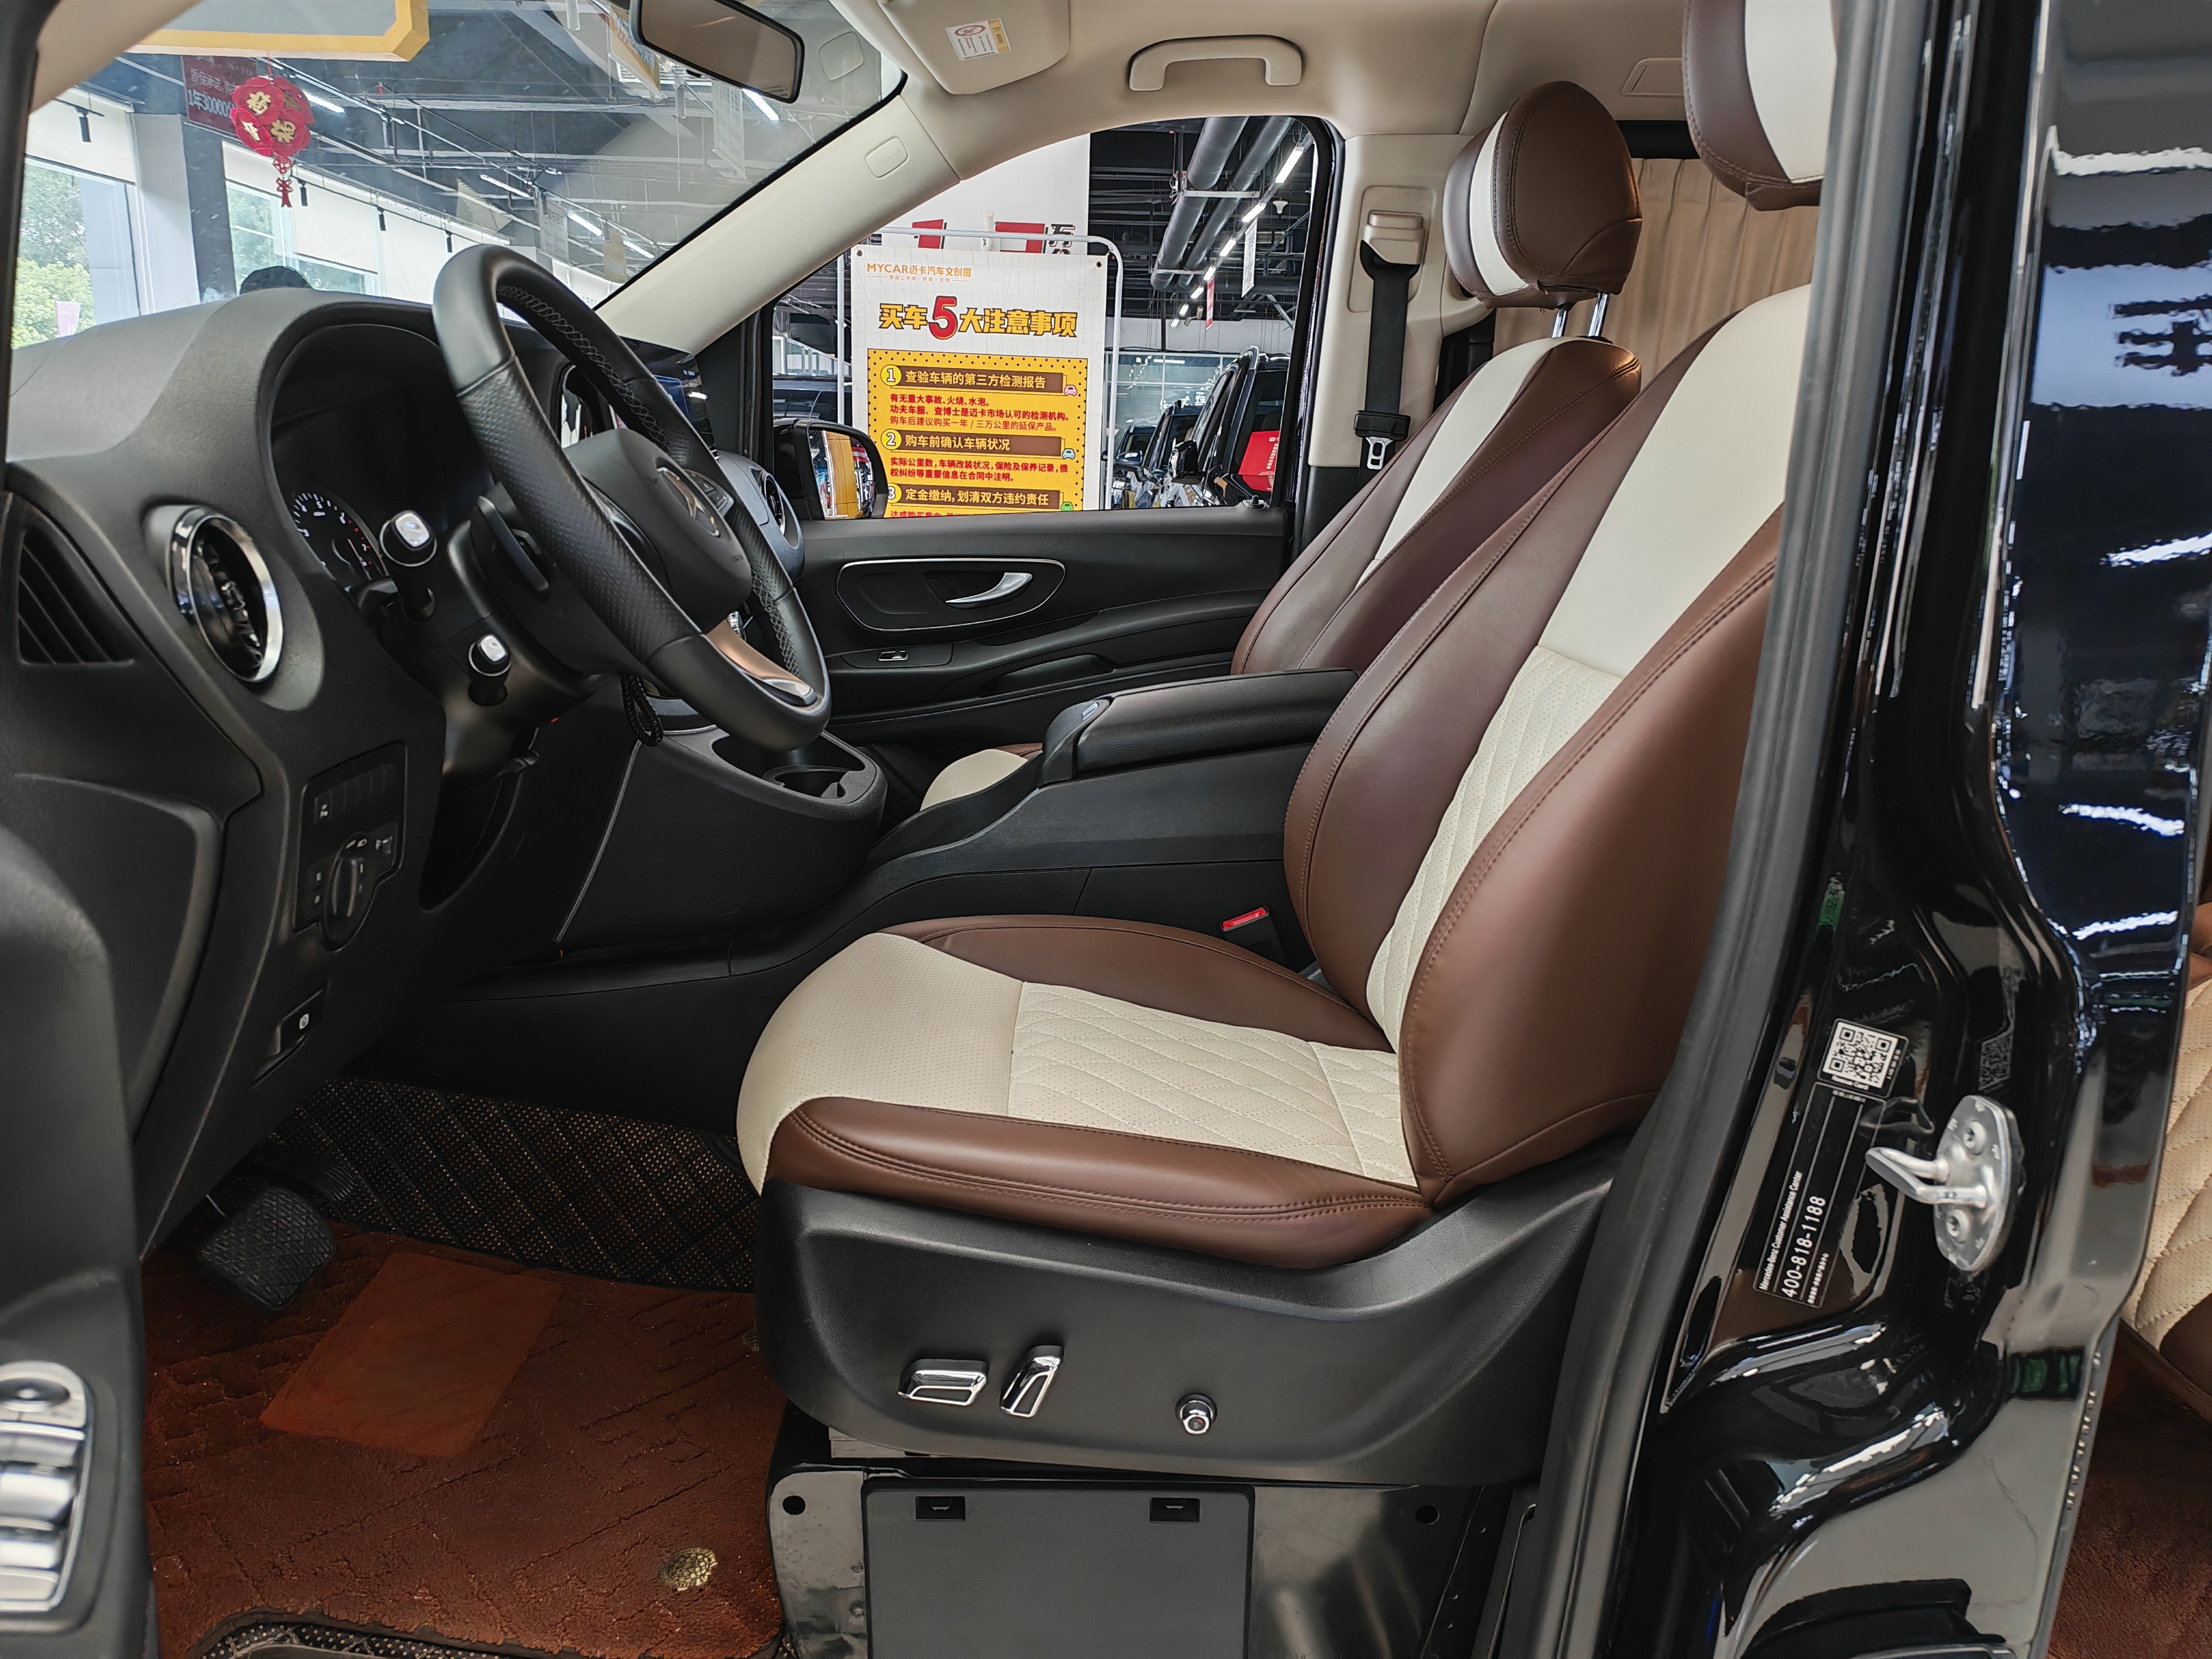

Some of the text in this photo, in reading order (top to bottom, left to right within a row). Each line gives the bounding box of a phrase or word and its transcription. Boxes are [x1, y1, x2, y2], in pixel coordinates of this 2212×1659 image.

[867, 263, 972, 278] MYCAR迈卡汽车文创园
[878, 295, 1078, 340] 买车5大注意事项
[887, 369, 1046, 389] 1 查验车辆的第三方检测报告
[887, 433, 1010, 451] 2 购车前确认车辆状况
[888, 487, 896, 500] 3
[1759, 1170, 1803, 1291] Mercedes-Benz Customer Assistance Center
[1782, 1196, 1826, 1298] 400-818-1188
